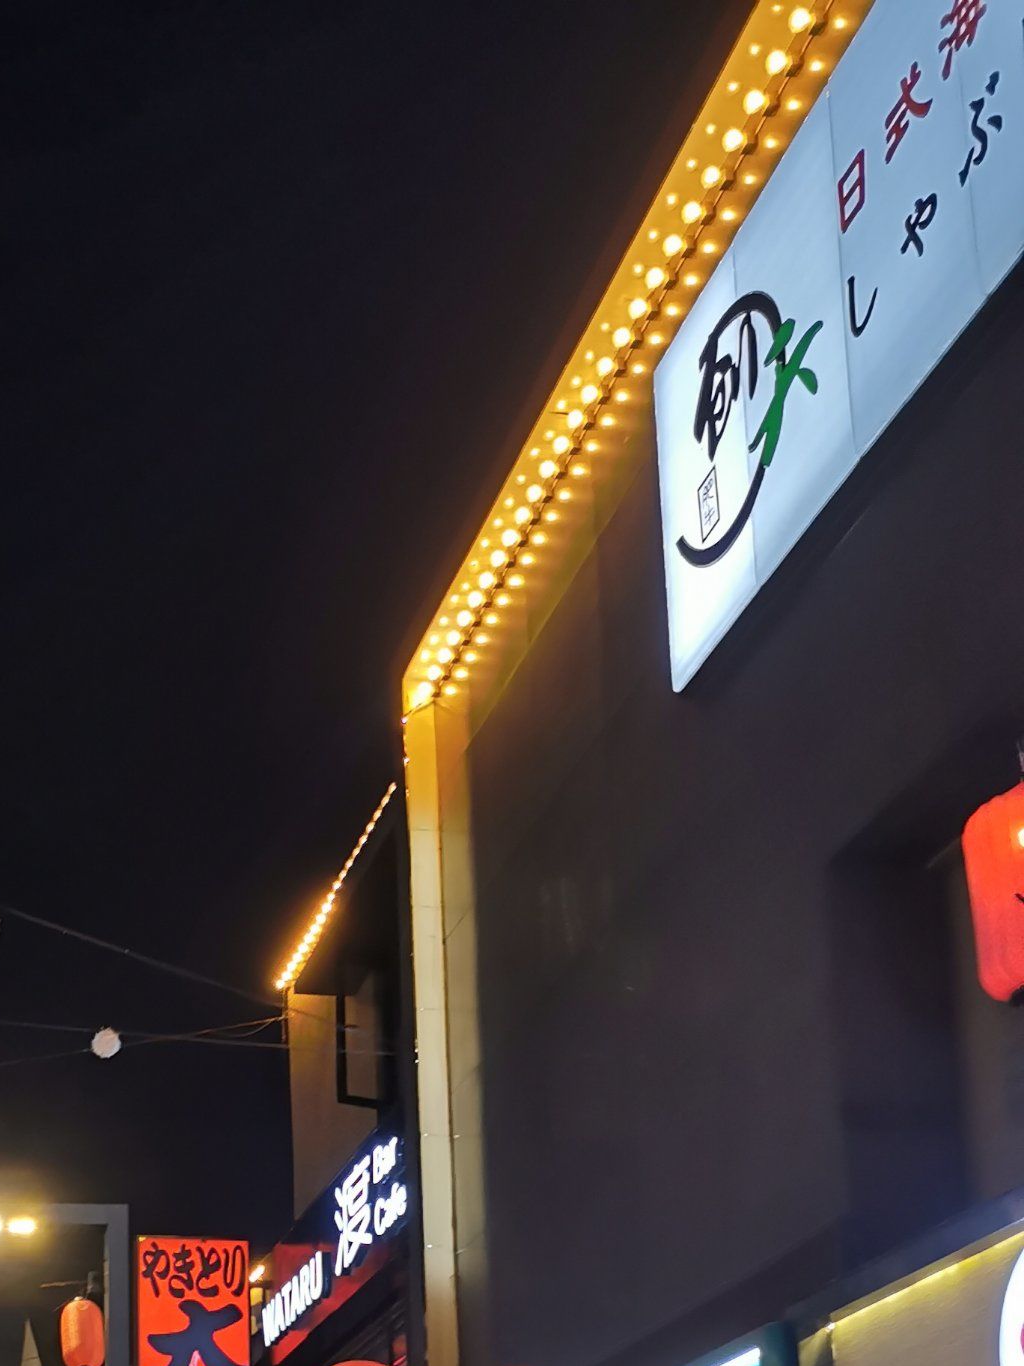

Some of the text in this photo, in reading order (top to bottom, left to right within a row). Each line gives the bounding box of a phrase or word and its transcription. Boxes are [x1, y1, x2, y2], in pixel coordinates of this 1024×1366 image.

[372, 1136, 398, 1184] Bar
[142, 1241, 246, 1299] やきとり
[261, 1250, 323, 1347] WATARU
